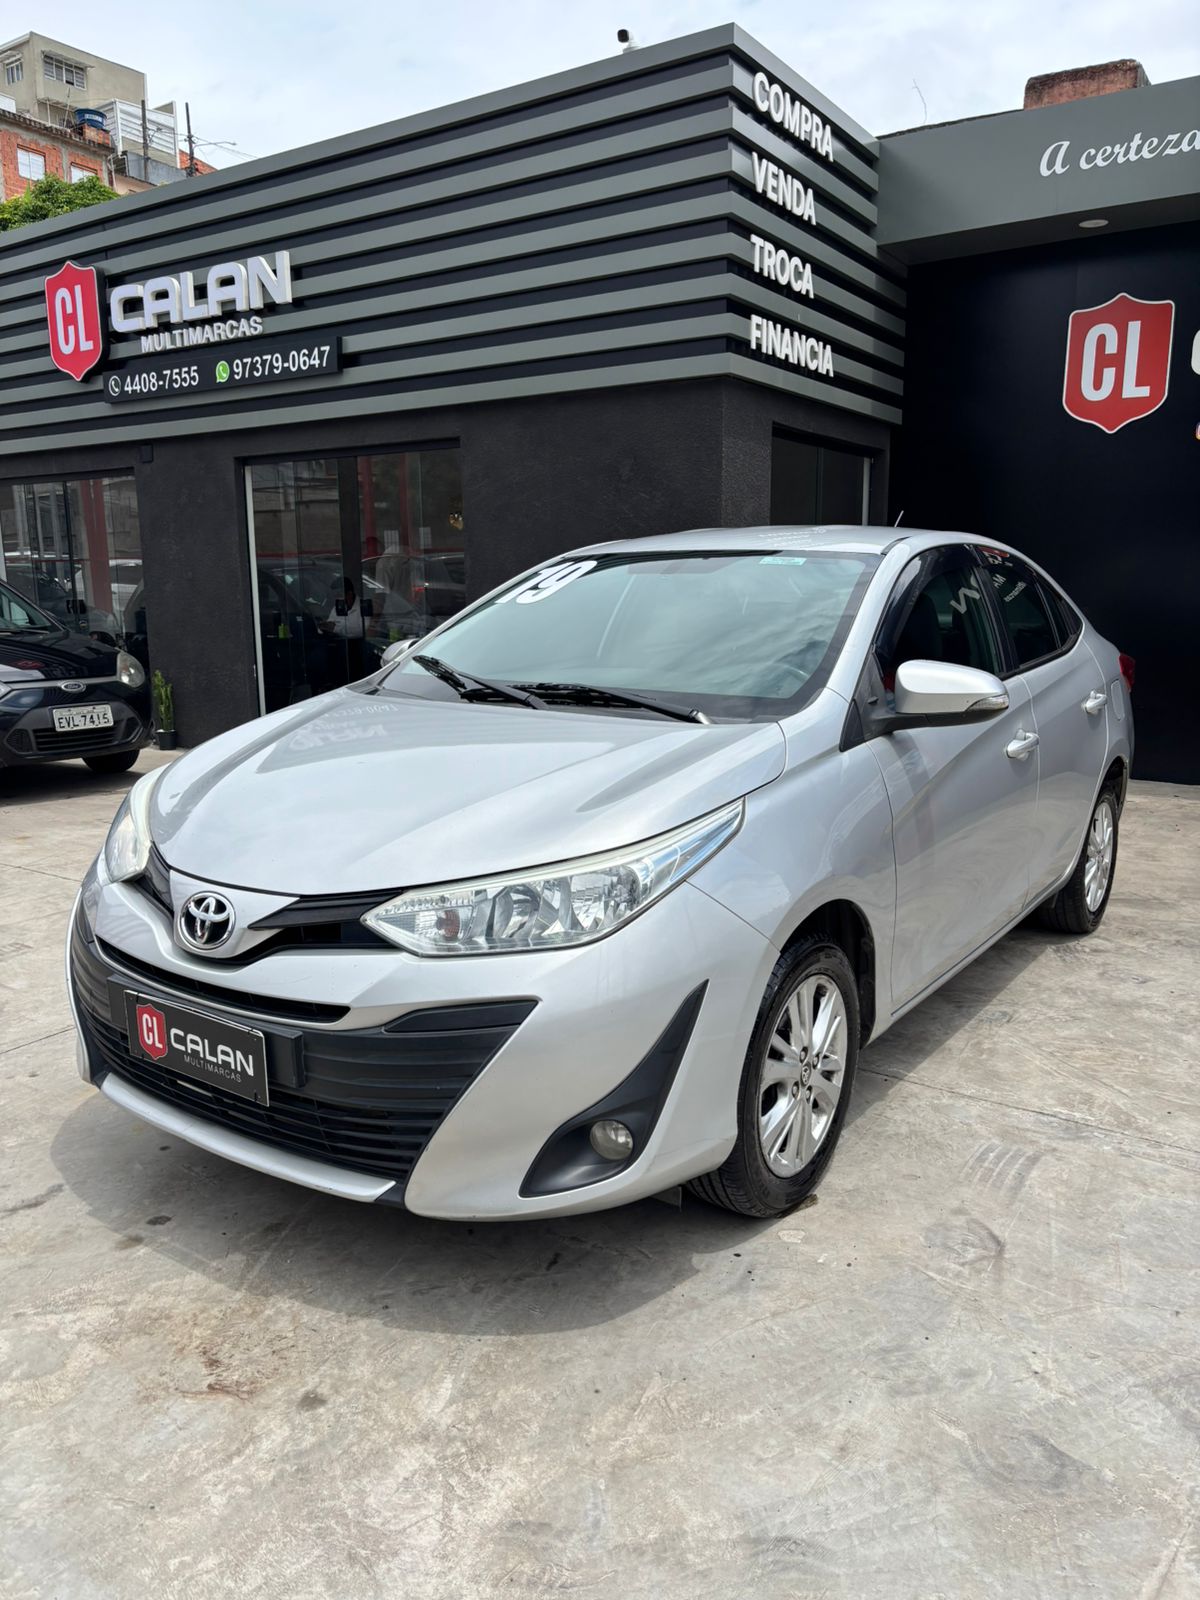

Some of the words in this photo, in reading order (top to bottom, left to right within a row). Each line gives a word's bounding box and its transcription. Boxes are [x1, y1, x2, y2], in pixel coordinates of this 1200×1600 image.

[753, 71, 834, 162] COMPRA
[1039, 140, 1070, 177] A
[1079, 129, 1200, 170] certeza
[752, 151, 816, 225] VENDA
[109, 250, 293, 334] CALAN
[751, 233, 814, 298] TROCA
[54, 284, 94, 355] CL
[141, 316, 264, 354] MULTIMARCAS
[750, 313, 834, 377] FINANCIA
[124, 365, 199, 395] 4408-7555
[233, 345, 330, 380] 97379-0647
[1081, 320, 1150, 401] CL
[494, 560, 598, 605] 19
[142, 1012, 163, 1049] CL
[170, 1027, 254, 1077] CALAN
[183, 1054, 242, 1083] MULTIMARCAS
